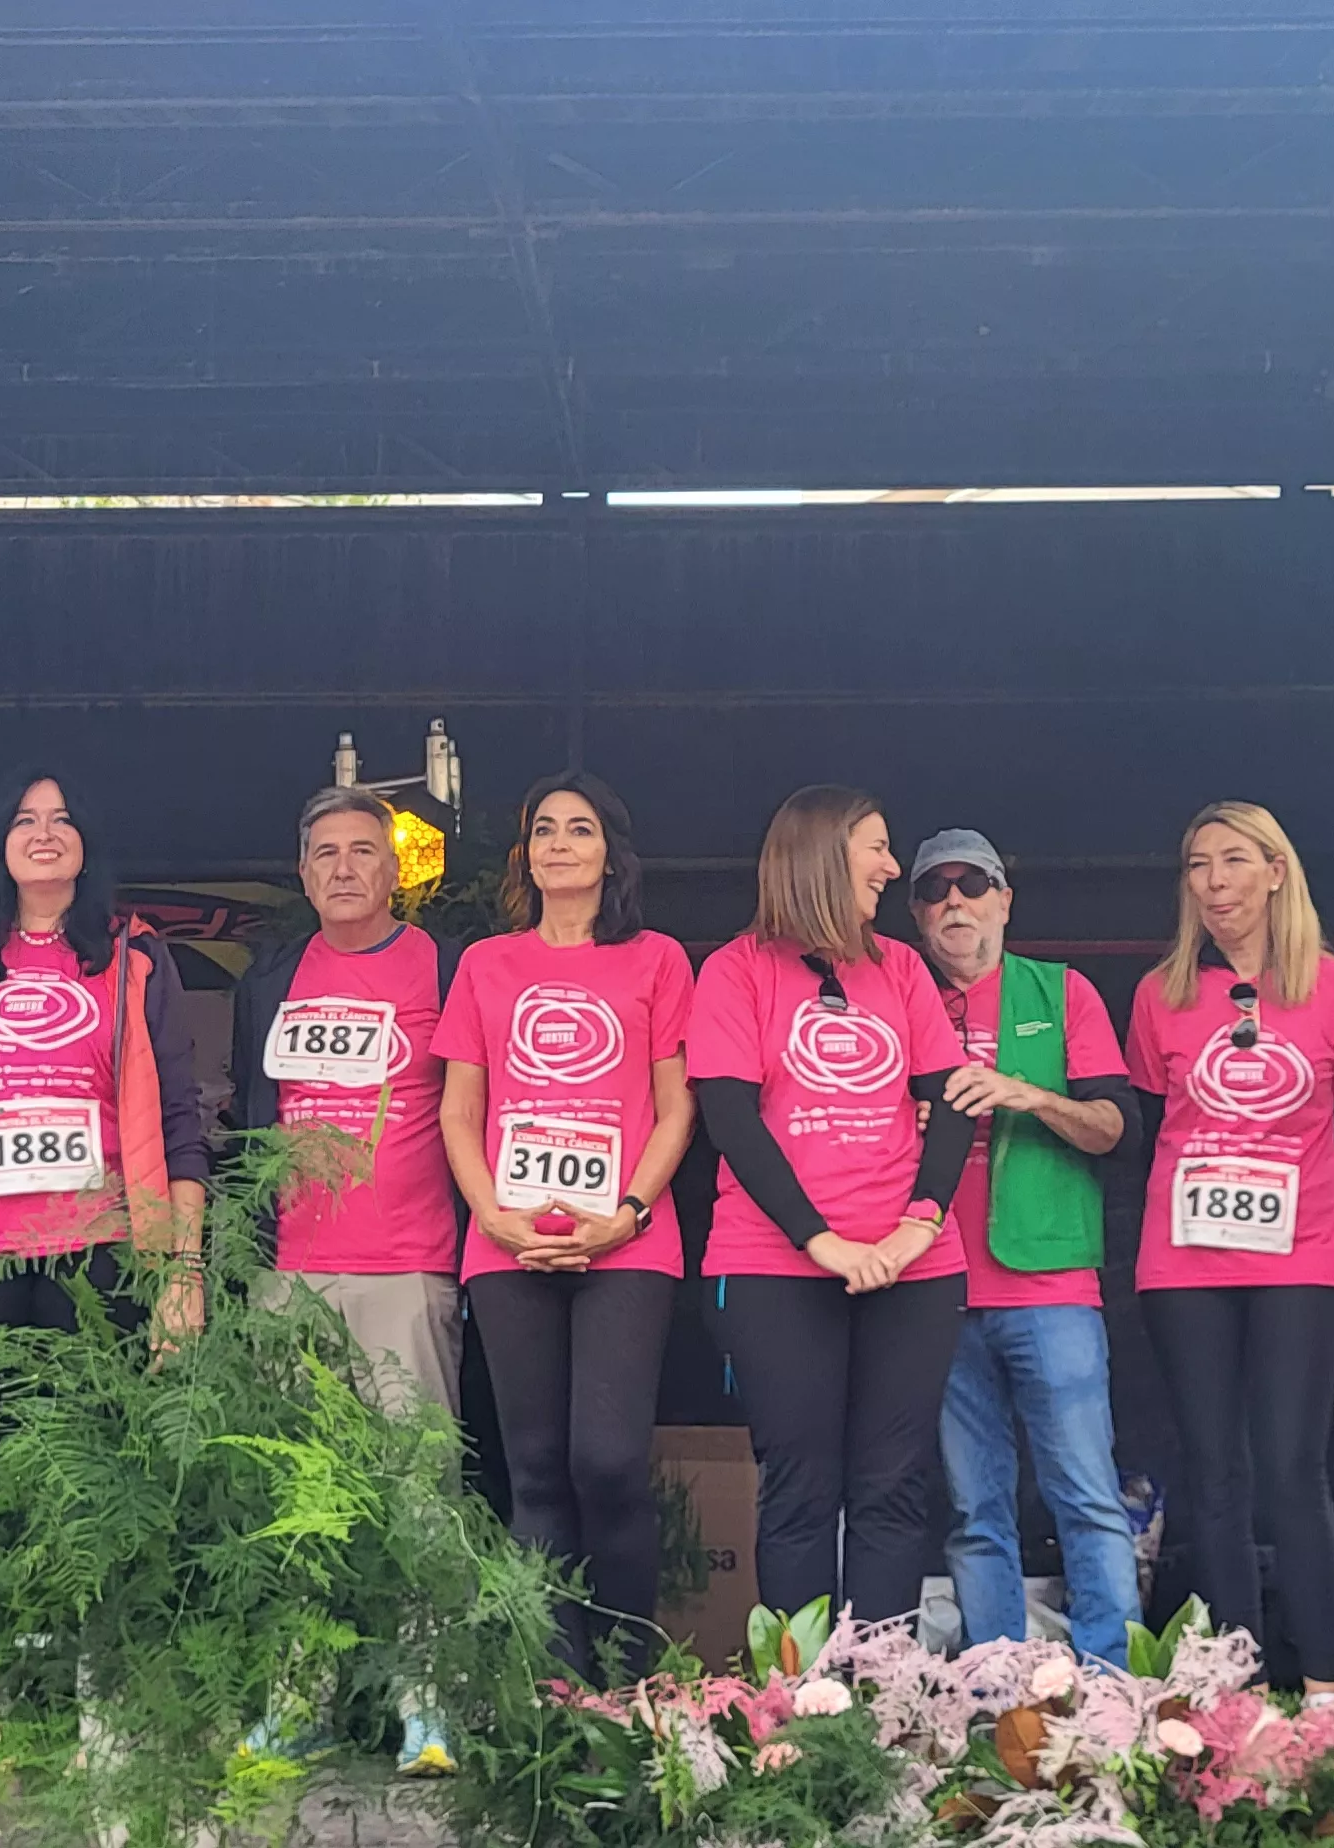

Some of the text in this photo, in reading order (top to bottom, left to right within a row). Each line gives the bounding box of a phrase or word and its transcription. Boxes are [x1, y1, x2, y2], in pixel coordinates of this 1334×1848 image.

[283, 1024, 380, 1056] 1887
[509, 1147, 607, 1190] 3109
[1186, 1187, 1281, 1224] 1889
